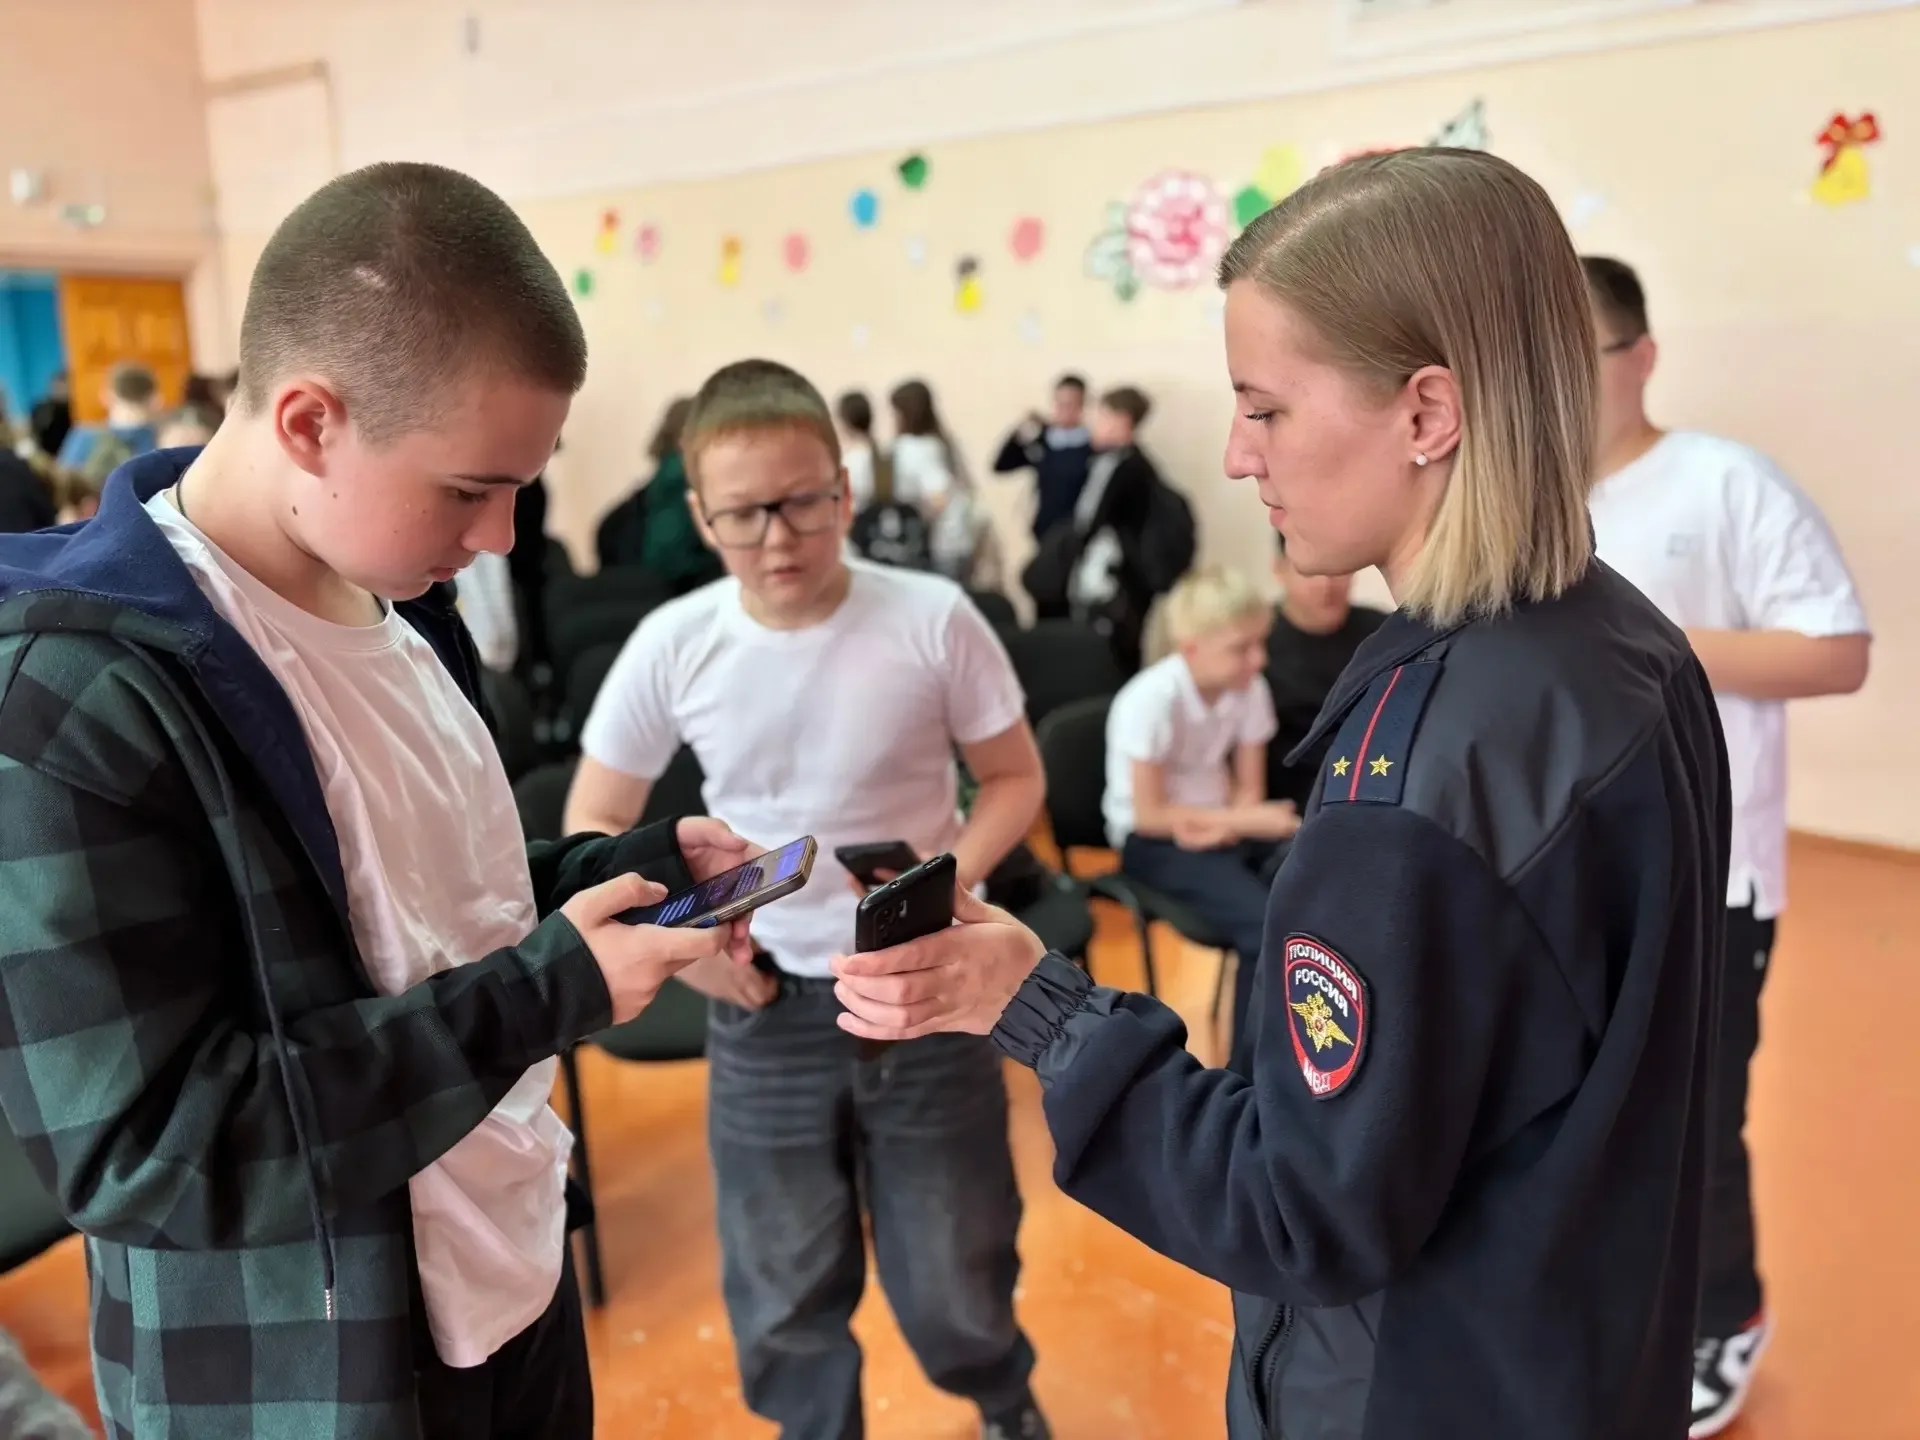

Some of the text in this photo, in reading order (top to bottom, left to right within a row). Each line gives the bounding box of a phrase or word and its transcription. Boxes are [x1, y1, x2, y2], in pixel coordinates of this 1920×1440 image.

[1288, 943, 1358, 1001] ПОЛИЦИЯ
[1295, 968, 1348, 1018] РОССИЯ
[1302, 1056, 1332, 1093] МВД
